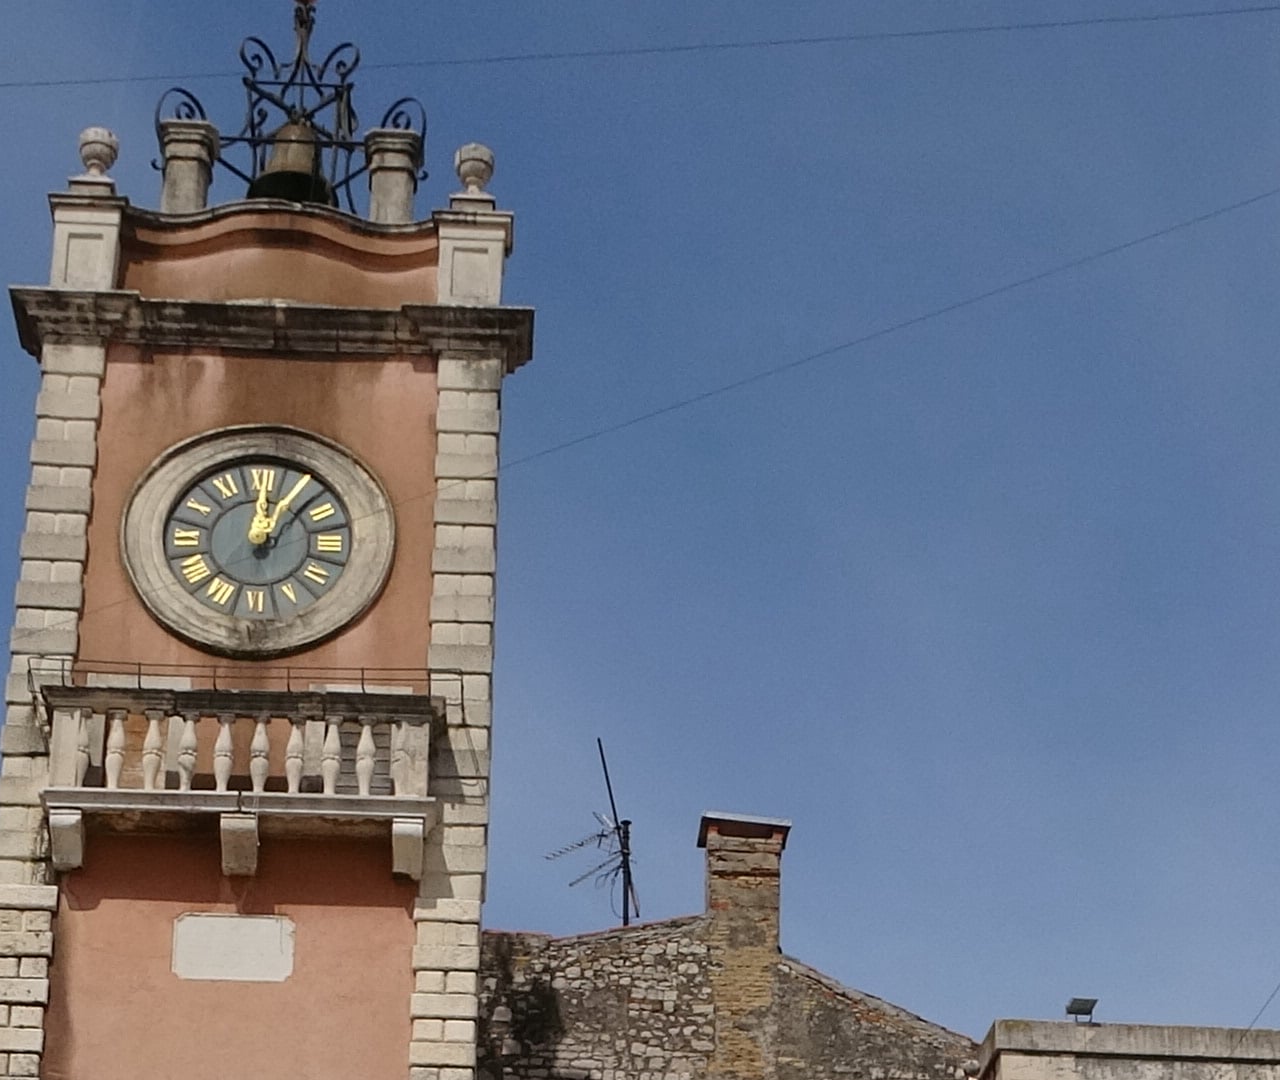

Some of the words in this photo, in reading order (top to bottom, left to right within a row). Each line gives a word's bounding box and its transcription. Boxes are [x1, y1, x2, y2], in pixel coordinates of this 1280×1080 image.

[213, 474, 238, 498] XI
[187, 498, 211, 516] X
[309, 503, 335, 521] II
[174, 528, 200, 546] IX
[317, 535, 342, 551] III
[304, 562, 330, 585] IV
[207, 577, 235, 605] VII
[246, 591, 264, 612] VI
[281, 583, 297, 604] V
